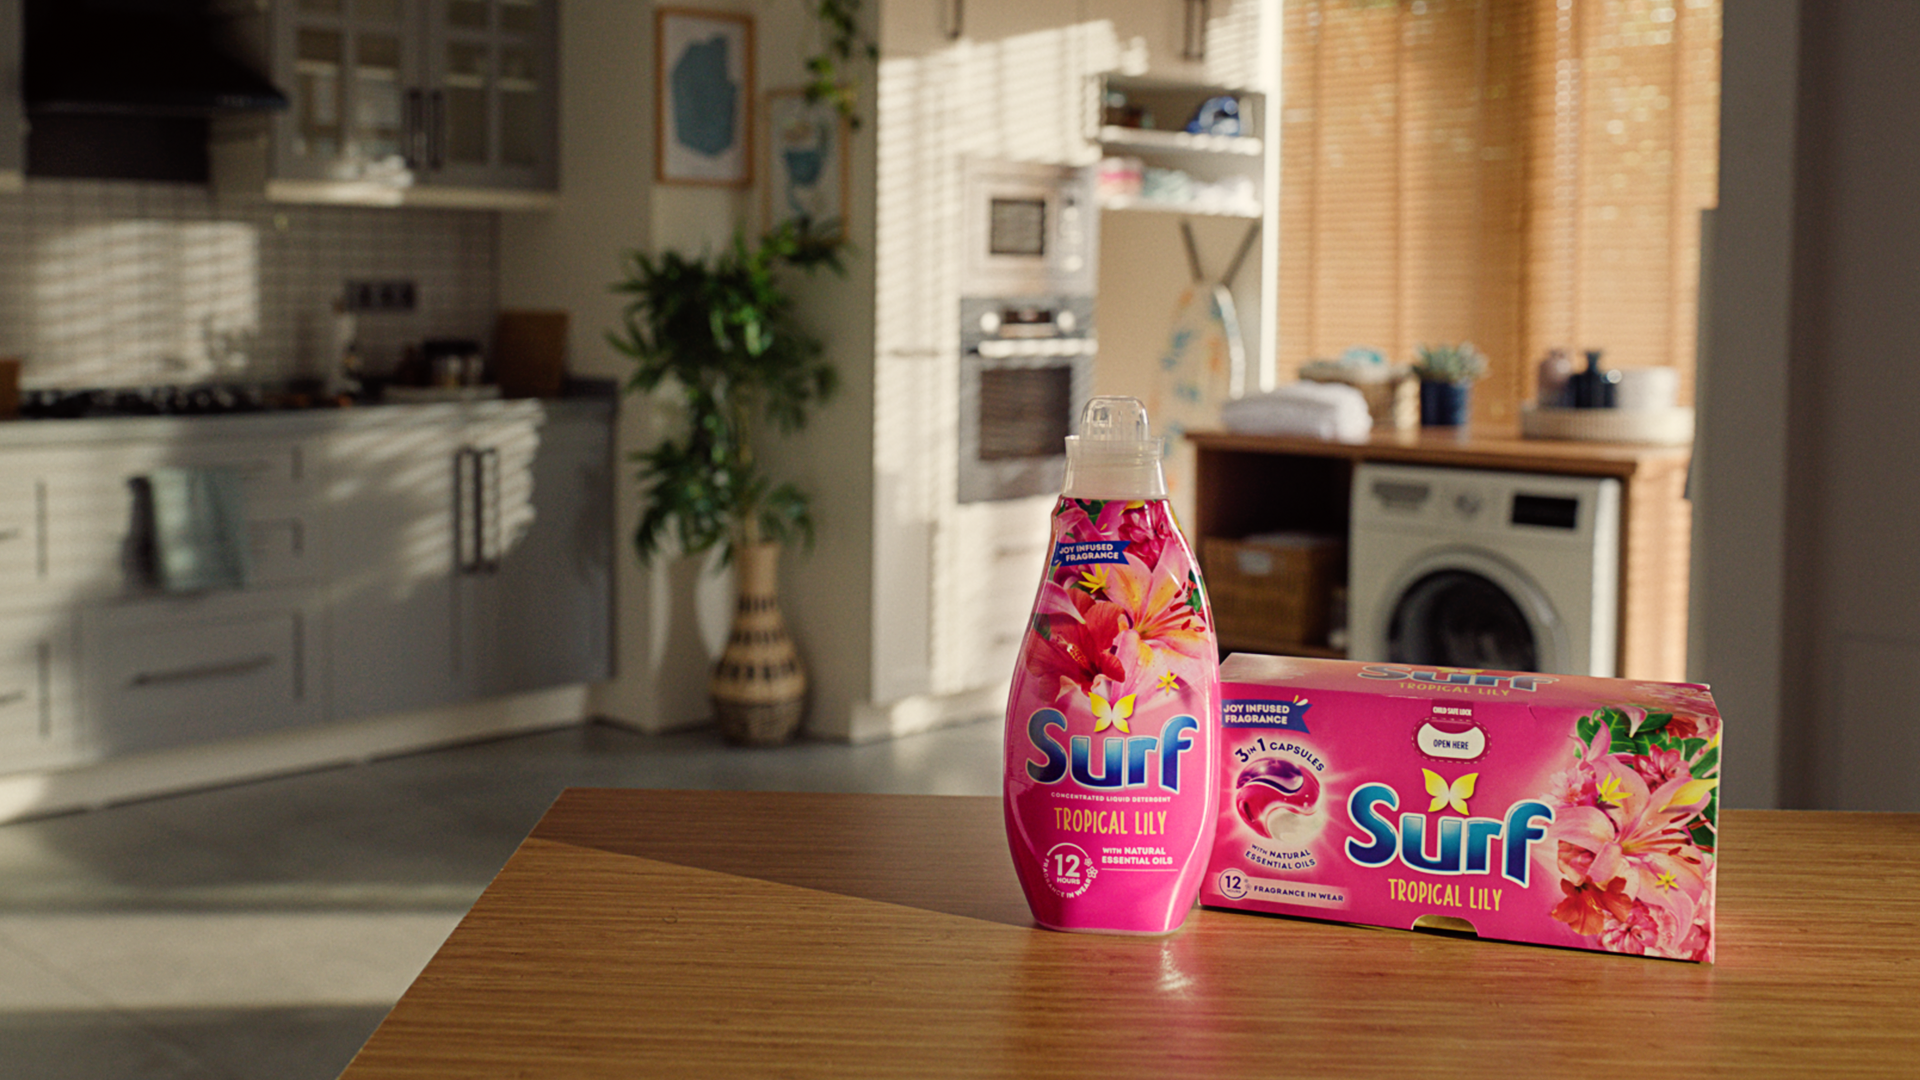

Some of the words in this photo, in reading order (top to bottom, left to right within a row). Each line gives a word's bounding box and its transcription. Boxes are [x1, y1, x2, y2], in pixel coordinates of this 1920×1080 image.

[1059, 546, 1075, 554] JOY
[1076, 543, 1114, 553] INFUSED
[1065, 552, 1119, 562] FRAGRANCE
[1357, 665, 1560, 692] Surf
[1399, 682, 1471, 694] TROPICAL
[1478, 687, 1510, 697] LILY
[1223, 704, 1244, 713] JOY
[1245, 704, 1290, 714] INFUSED
[1225, 714, 1288, 725] FRAGRANCE
[1025, 707, 1199, 794] Surf
[1433, 738, 1451, 748] OPEN
[1452, 740, 1469, 750] HERE
[1269, 741, 1325, 772] CAPSULES
[1051, 791, 1105, 802] CONCENTRATED
[1106, 795, 1131, 803] LIQUID
[1054, 807, 1128, 835] TROPICAL
[1135, 810, 1167, 836] LILY
[1344, 782, 1555, 889] Surf
[1102, 847, 1123, 855] WITH
[1123, 846, 1167, 856] NATURAL
[1251, 843, 1268, 855] WITH
[1269, 849, 1311, 860] NATURAL
[1054, 853, 1081, 878] 12
[1101, 855, 1151, 865] ESSENTIAL
[1151, 856, 1173, 865] OILS
[1245, 850, 1292, 870] ESSENTIAL
[1294, 858, 1316, 870] OILS
[1056, 876, 1081, 885] HOURS
[1225, 875, 1242, 890] 12
[1253, 885, 1306, 898] FRAGRANCE
[1318, 892, 1344, 902] WEAR
[1388, 877, 1463, 907] TROPICAL
[1469, 885, 1503, 912] LILY
